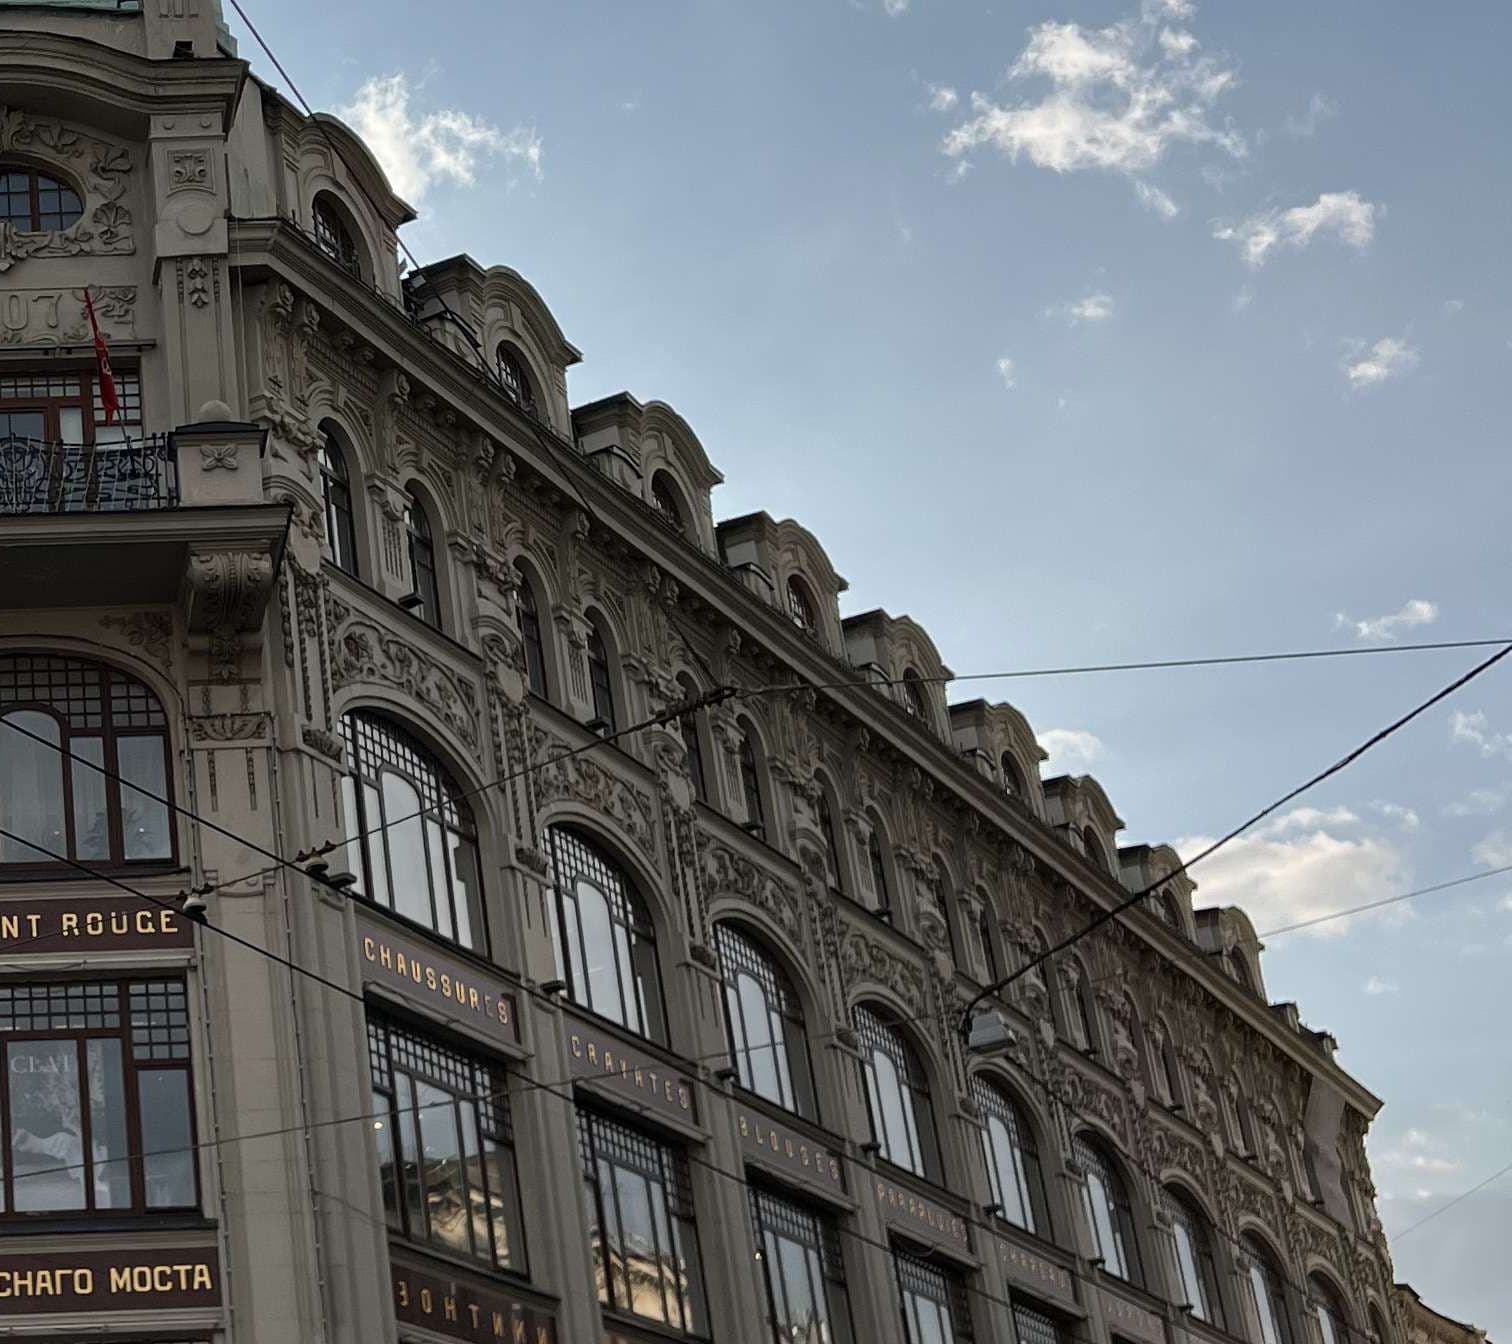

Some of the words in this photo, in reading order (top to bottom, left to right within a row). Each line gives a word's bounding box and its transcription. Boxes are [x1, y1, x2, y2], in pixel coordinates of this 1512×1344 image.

[61, 909, 179, 937] ROUGE
[363, 936, 509, 1025] CHAUSSURES
[108, 1262, 214, 1294] МОСТА
